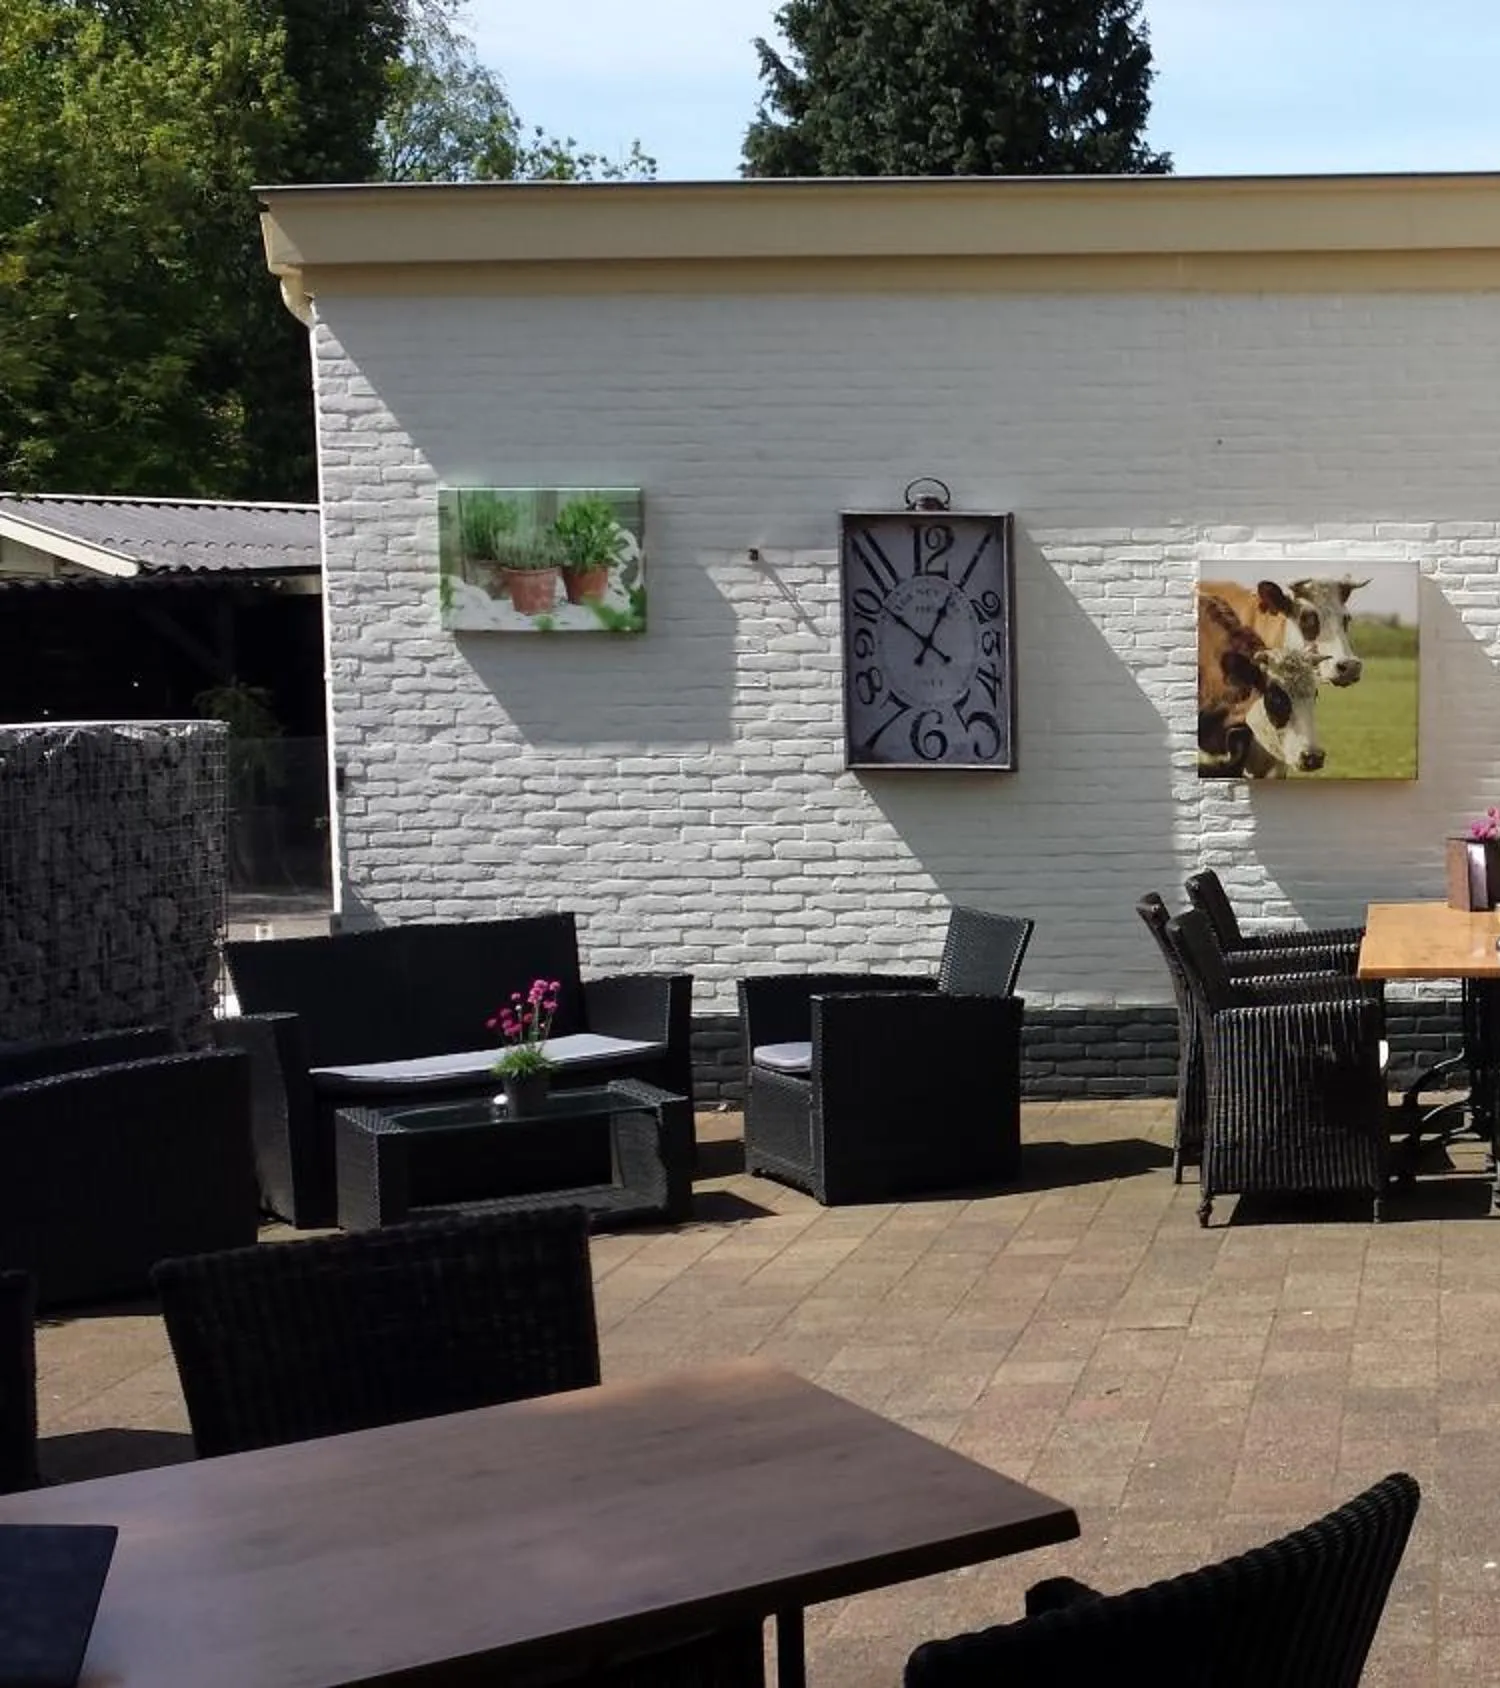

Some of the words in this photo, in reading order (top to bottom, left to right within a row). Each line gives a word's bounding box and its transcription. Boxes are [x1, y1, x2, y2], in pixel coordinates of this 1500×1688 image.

[912, 522, 953, 579] 12
[852, 588, 883, 624] 10
[854, 627, 876, 660] 9
[855, 666, 883, 704] 8
[867, 690, 912, 752] 7
[909, 709, 948, 760] 6
[953, 688, 1000, 759] 5
